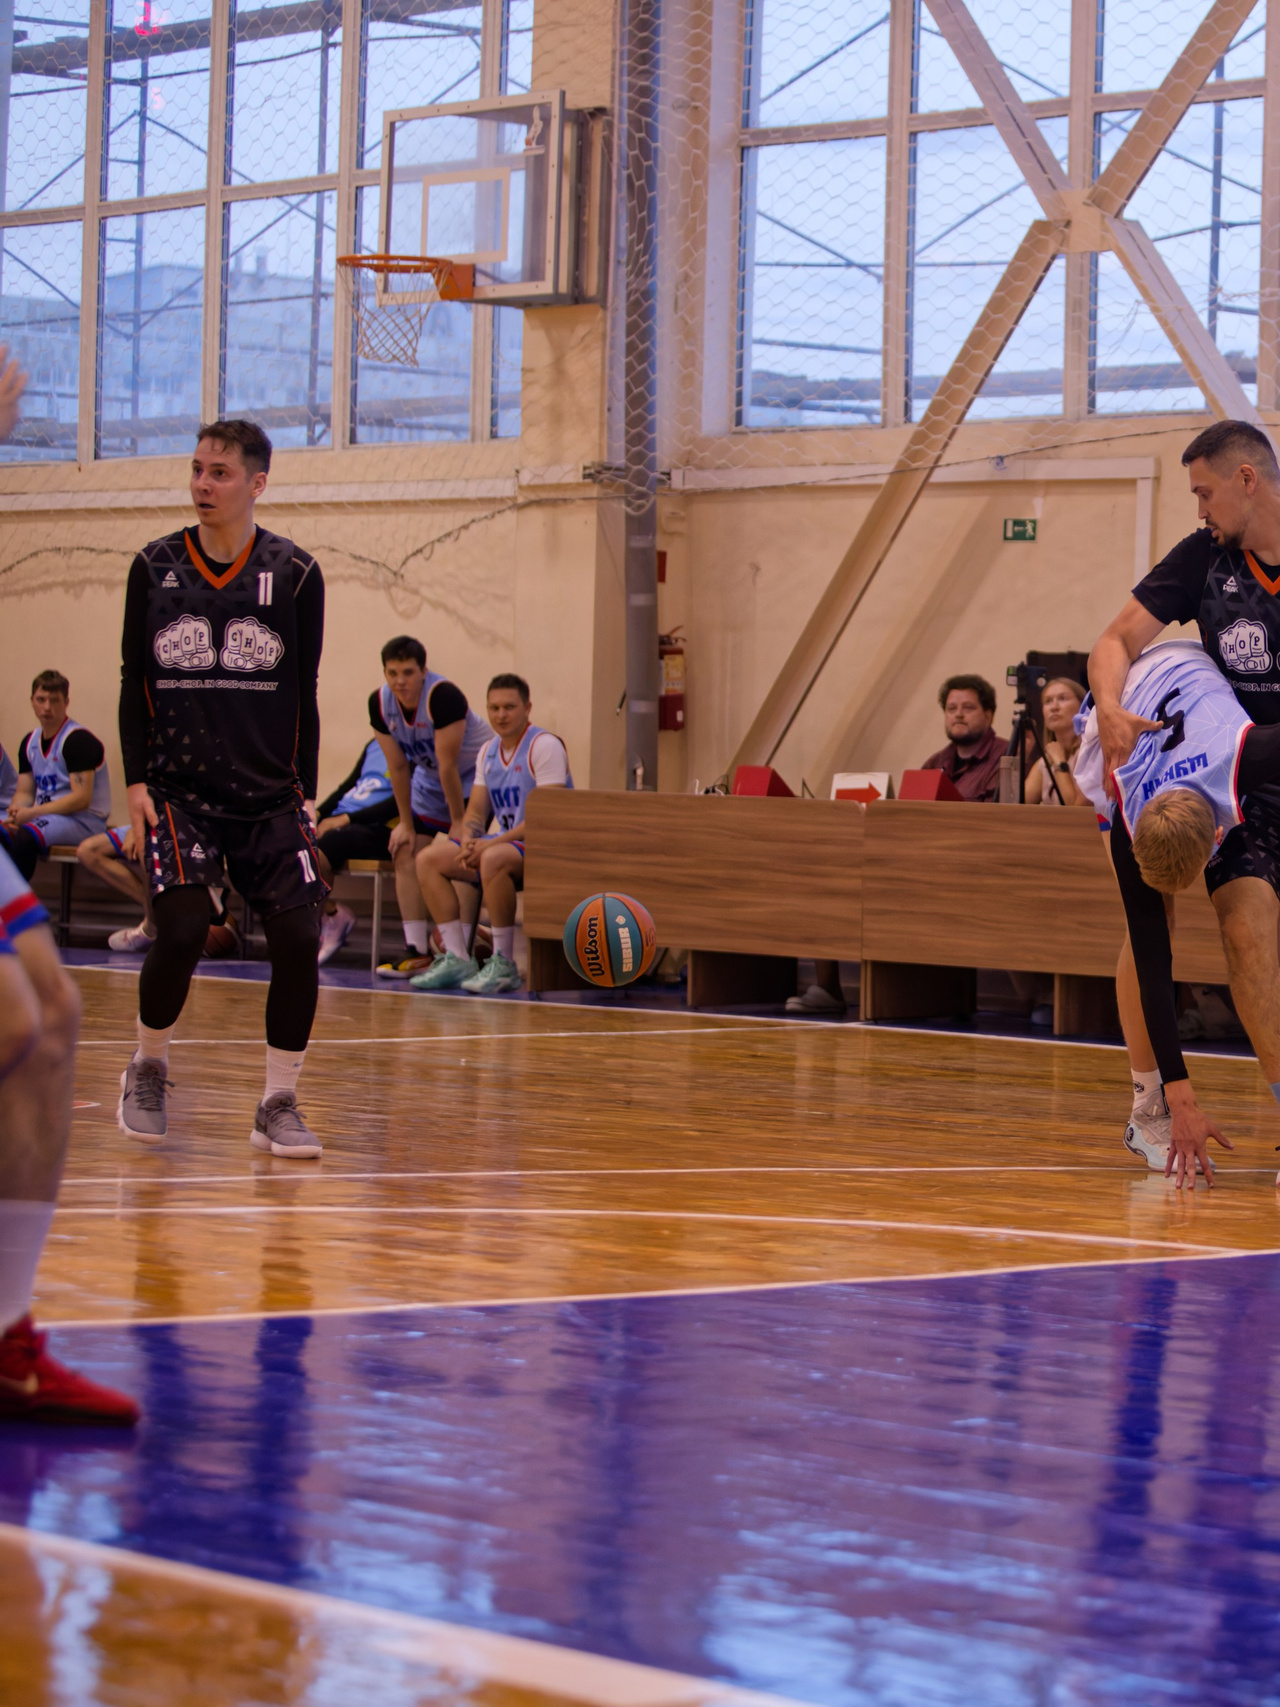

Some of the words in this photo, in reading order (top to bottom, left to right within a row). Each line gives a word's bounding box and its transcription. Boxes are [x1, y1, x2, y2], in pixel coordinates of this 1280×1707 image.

[258, 572, 273, 606] 11
[1223, 584, 1239, 593] PEAK
[215, 680, 240, 689] GOOD
[240, 680, 279, 691] COMPANY
[1261, 683, 1271, 692] IN
[298, 849, 316, 883] 11
[584, 916, 605, 977] Wilson
[618, 927, 633, 973] SIBUR
